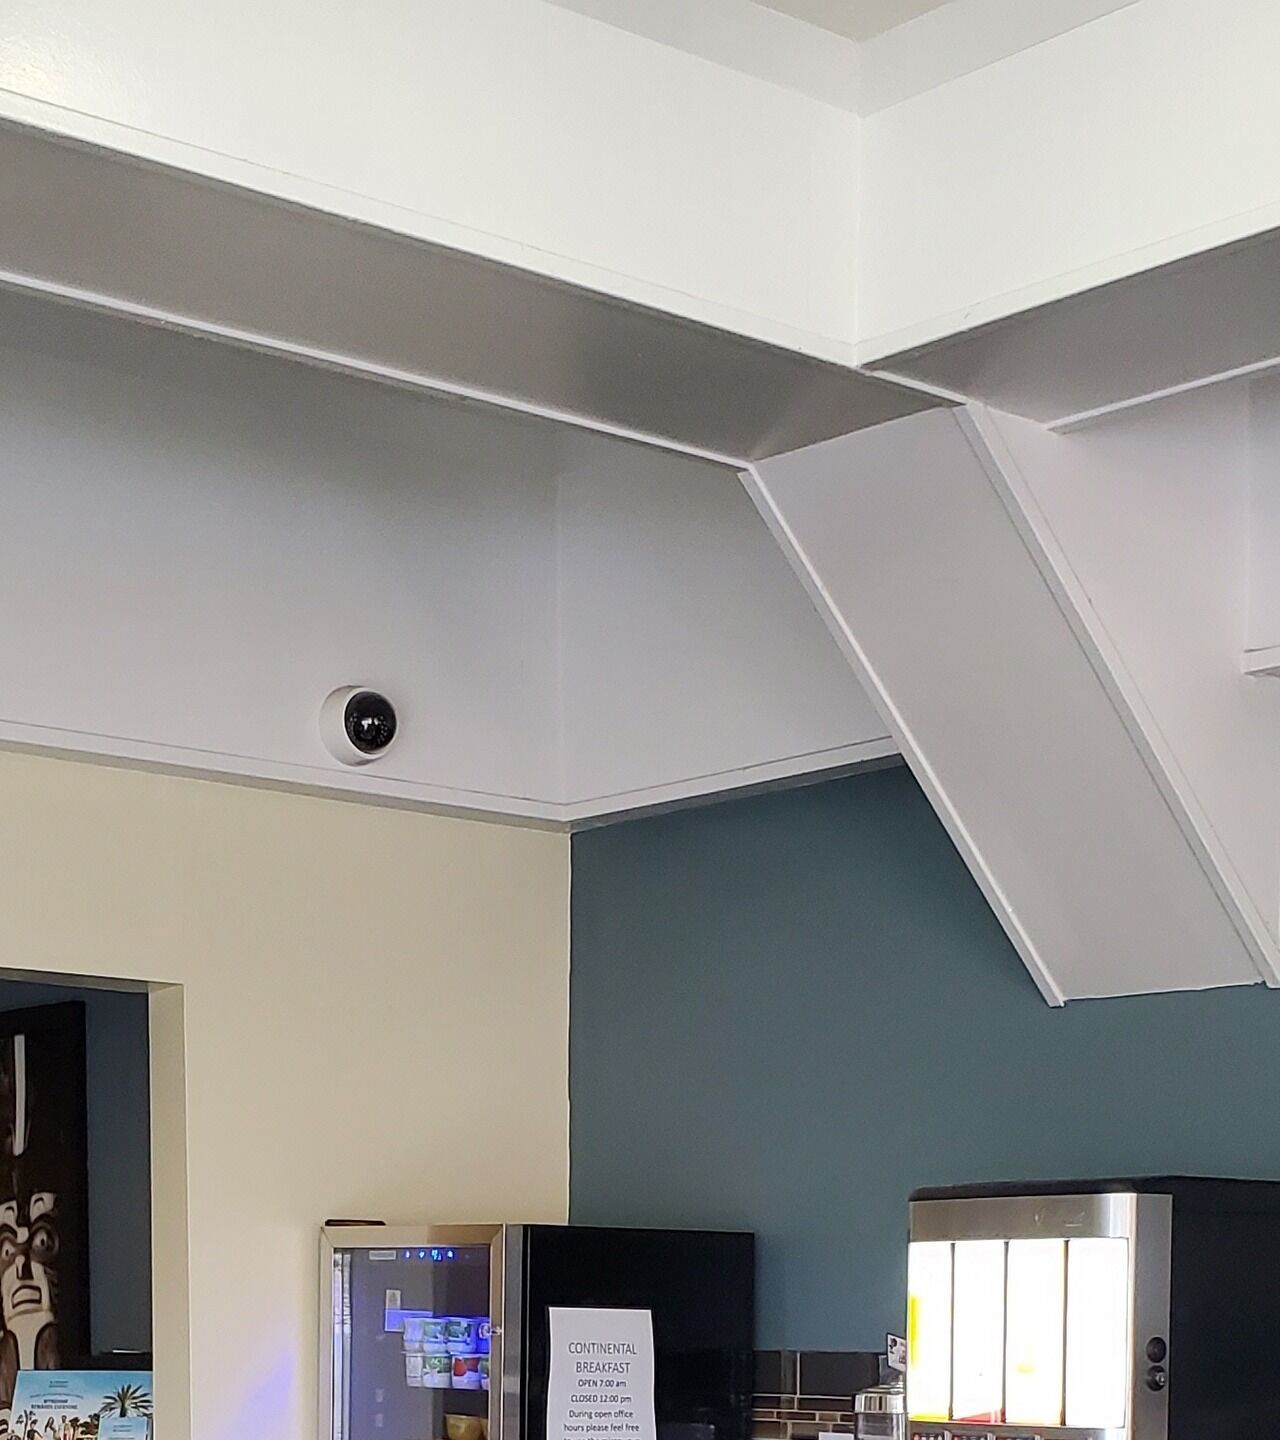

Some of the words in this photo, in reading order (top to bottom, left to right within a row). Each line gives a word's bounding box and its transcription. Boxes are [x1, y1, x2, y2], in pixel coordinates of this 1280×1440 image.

[568, 1342, 637, 1355] CONTINENTAL
[576, 1361, 631, 1374] BREAKFAST
[578, 1379, 598, 1388] OPEN
[600, 1379, 615, 1388] 7:00
[570, 1394, 598, 1403] CLOSED
[600, 1394, 619, 1403] 12:00
[620, 1396, 632, 1404] pm
[569, 1409, 593, 1420] During
[594, 1411, 612, 1419] open
[614, 1409, 634, 1418] office
[563, 1424, 585, 1432] hours
[586, 1424, 609, 1433] please
[611, 1423, 624, 1432] feel
[625, 1423, 640, 1432] free
